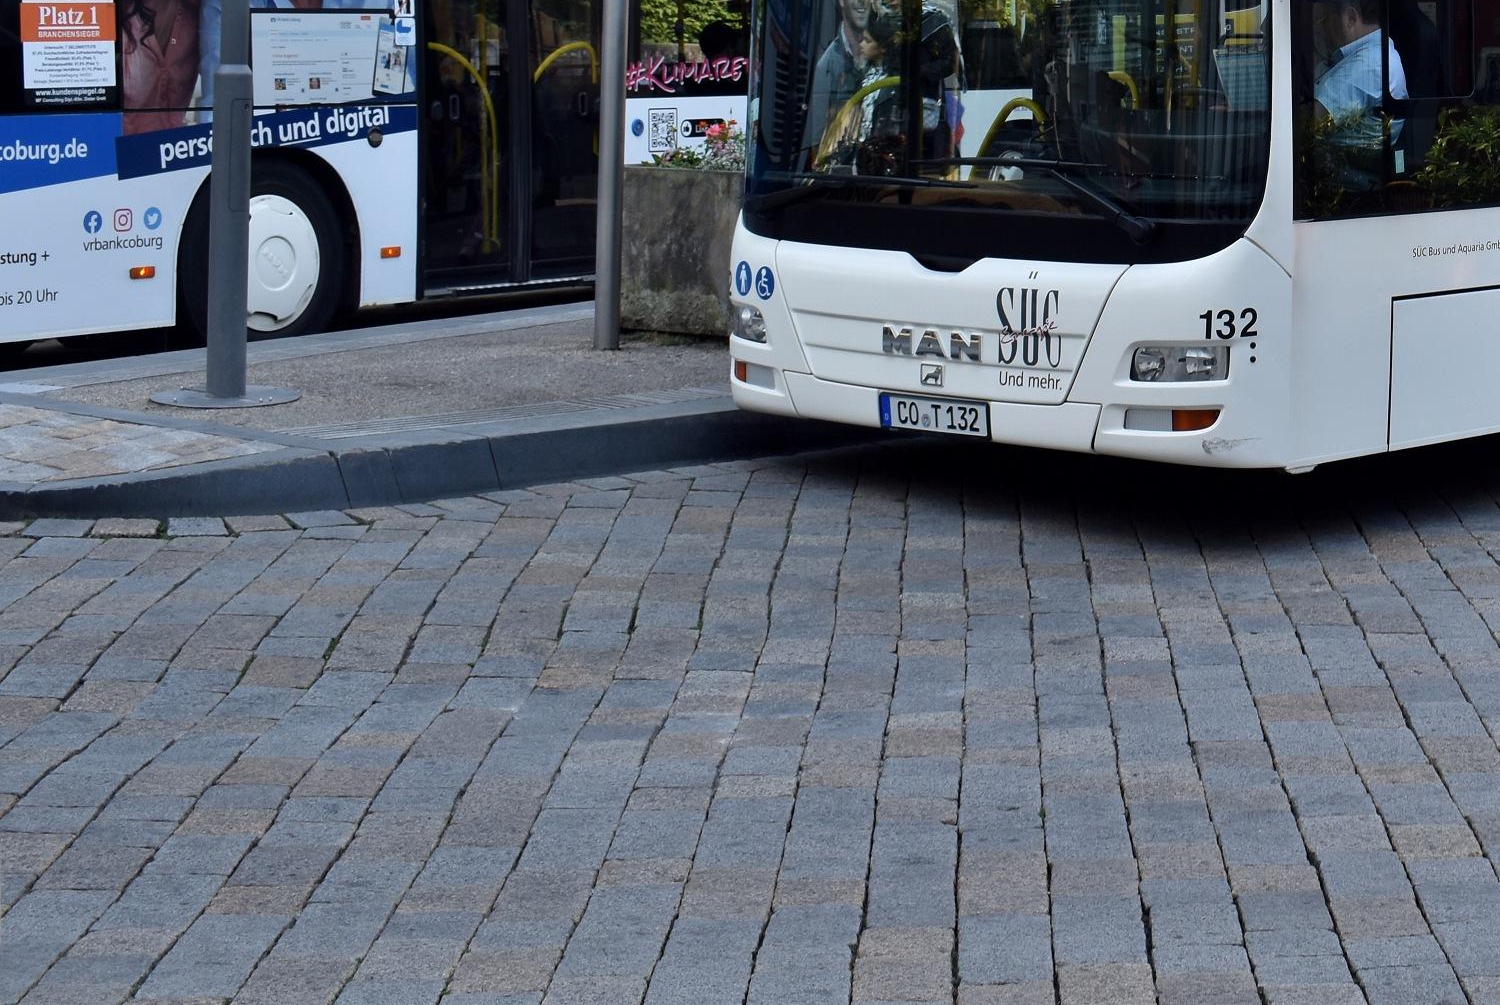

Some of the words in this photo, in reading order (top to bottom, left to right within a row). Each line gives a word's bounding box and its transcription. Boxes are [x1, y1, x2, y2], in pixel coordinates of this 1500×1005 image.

[38, 6, 84, 25] Platz
[90, 6, 97, 25] 1
[38, 30, 101, 38] BRANCHENSIEGER
[35, 88, 106, 97] www.kundenspiegel.de
[279, 113, 320, 142] und
[325, 106, 389, 138] digital
[83, 235, 163, 251] vrbankcoburg
[1412, 244, 1427, 258] SÜC
[1428, 246, 1441, 257] Bus
[1442, 244, 1456, 255] und
[1457, 241, 1485, 255] Aquaria
[17, 290, 33, 304] 20
[36, 288, 58, 303] Uhr
[997, 271, 1062, 368] SÜC
[1199, 307, 1258, 340] 132
[881, 324, 982, 363] MAN
[999, 370, 1024, 387] Und
[1028, 373, 1062, 390] mehr.
[897, 400, 919, 425] CO
[931, 404, 941, 428] T
[946, 405, 980, 432] 132
